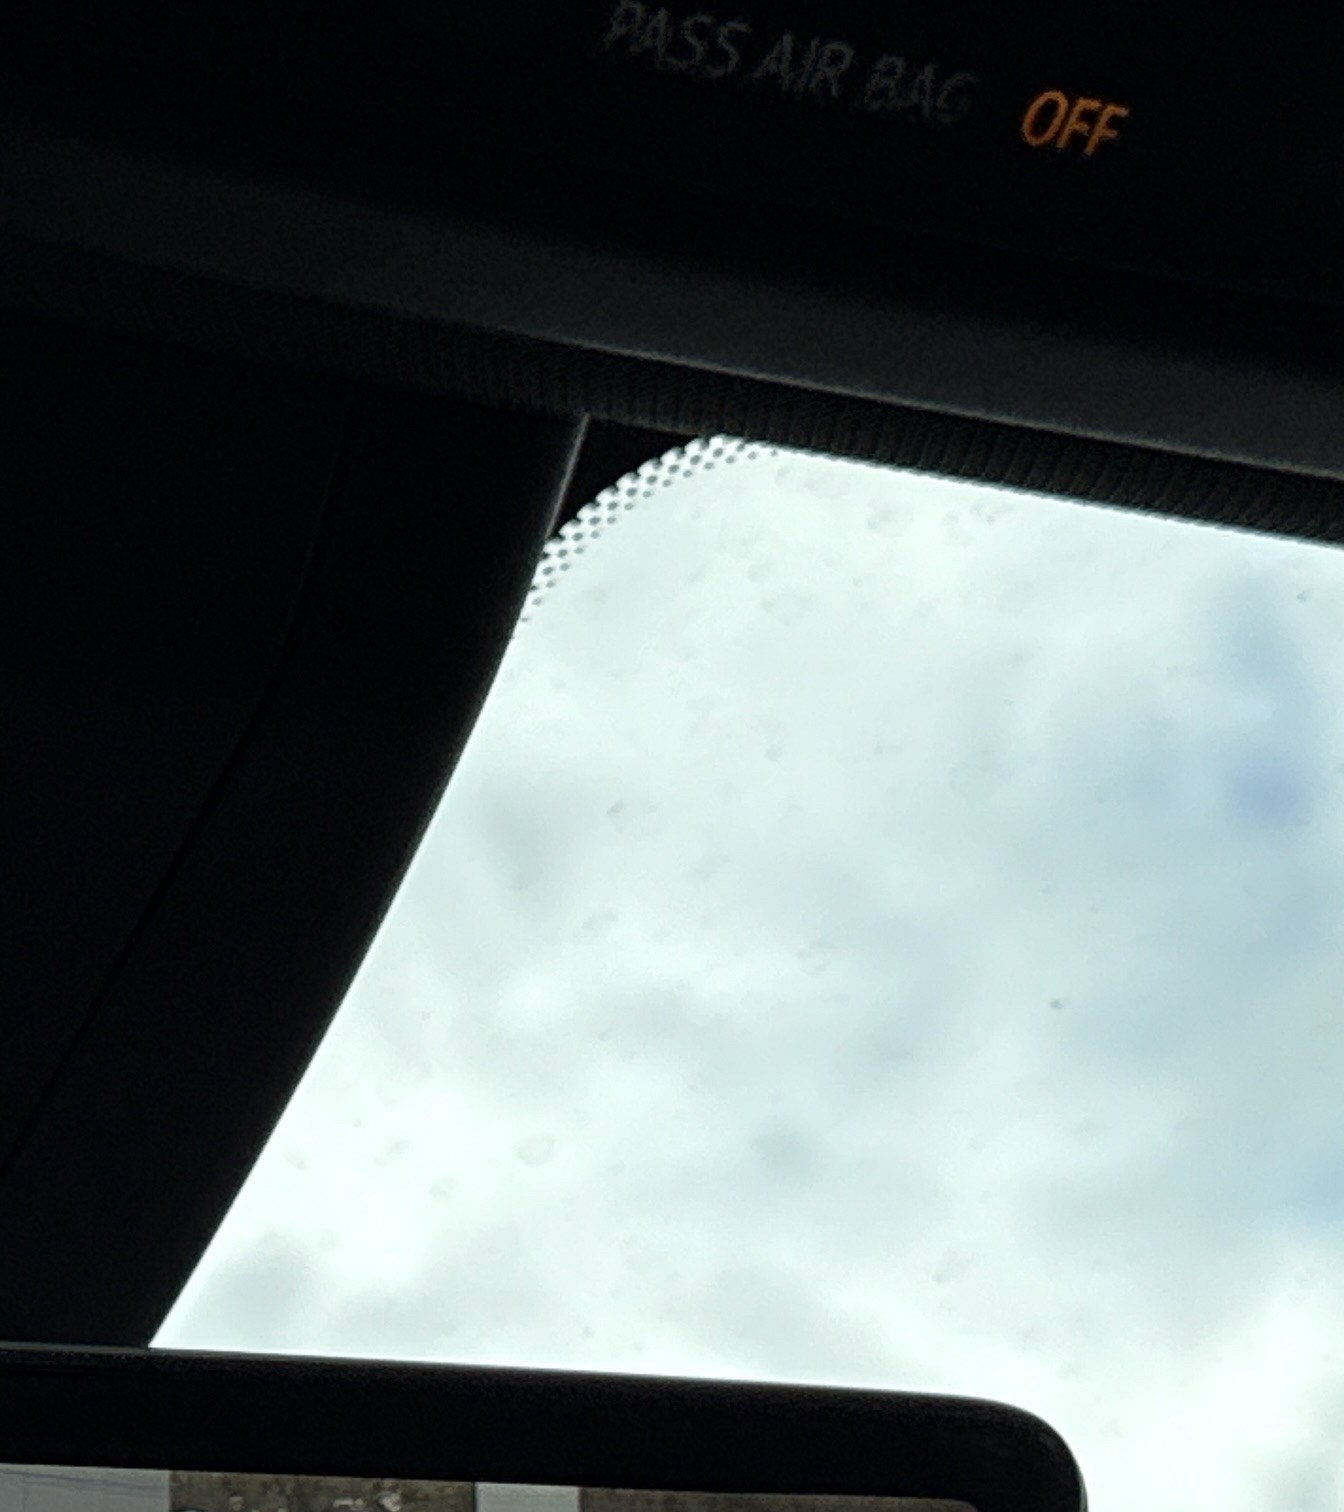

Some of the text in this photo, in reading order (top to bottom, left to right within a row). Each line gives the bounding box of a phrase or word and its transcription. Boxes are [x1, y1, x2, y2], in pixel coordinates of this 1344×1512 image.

[601, 0, 1132, 156] PASS AIR BAG OFF
